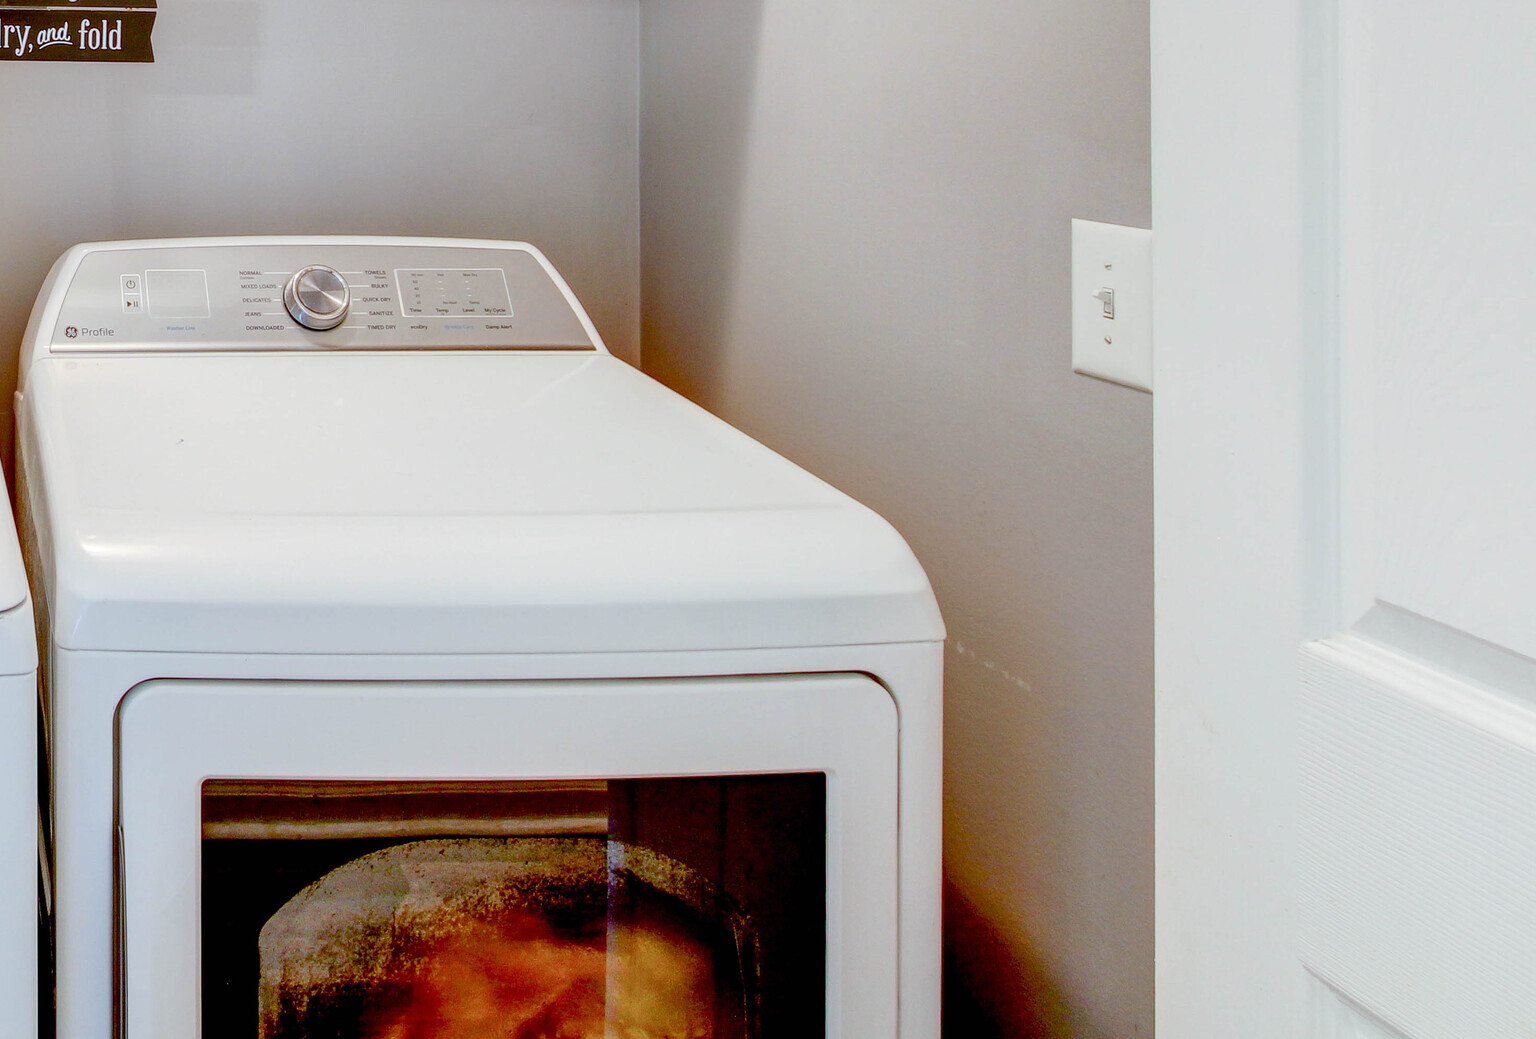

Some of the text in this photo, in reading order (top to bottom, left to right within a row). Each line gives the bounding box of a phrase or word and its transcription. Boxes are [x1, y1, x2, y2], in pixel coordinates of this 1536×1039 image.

[37, 22, 73, 48] and
[78, 18, 122, 51] fold
[81, 328, 114, 337] Profile
